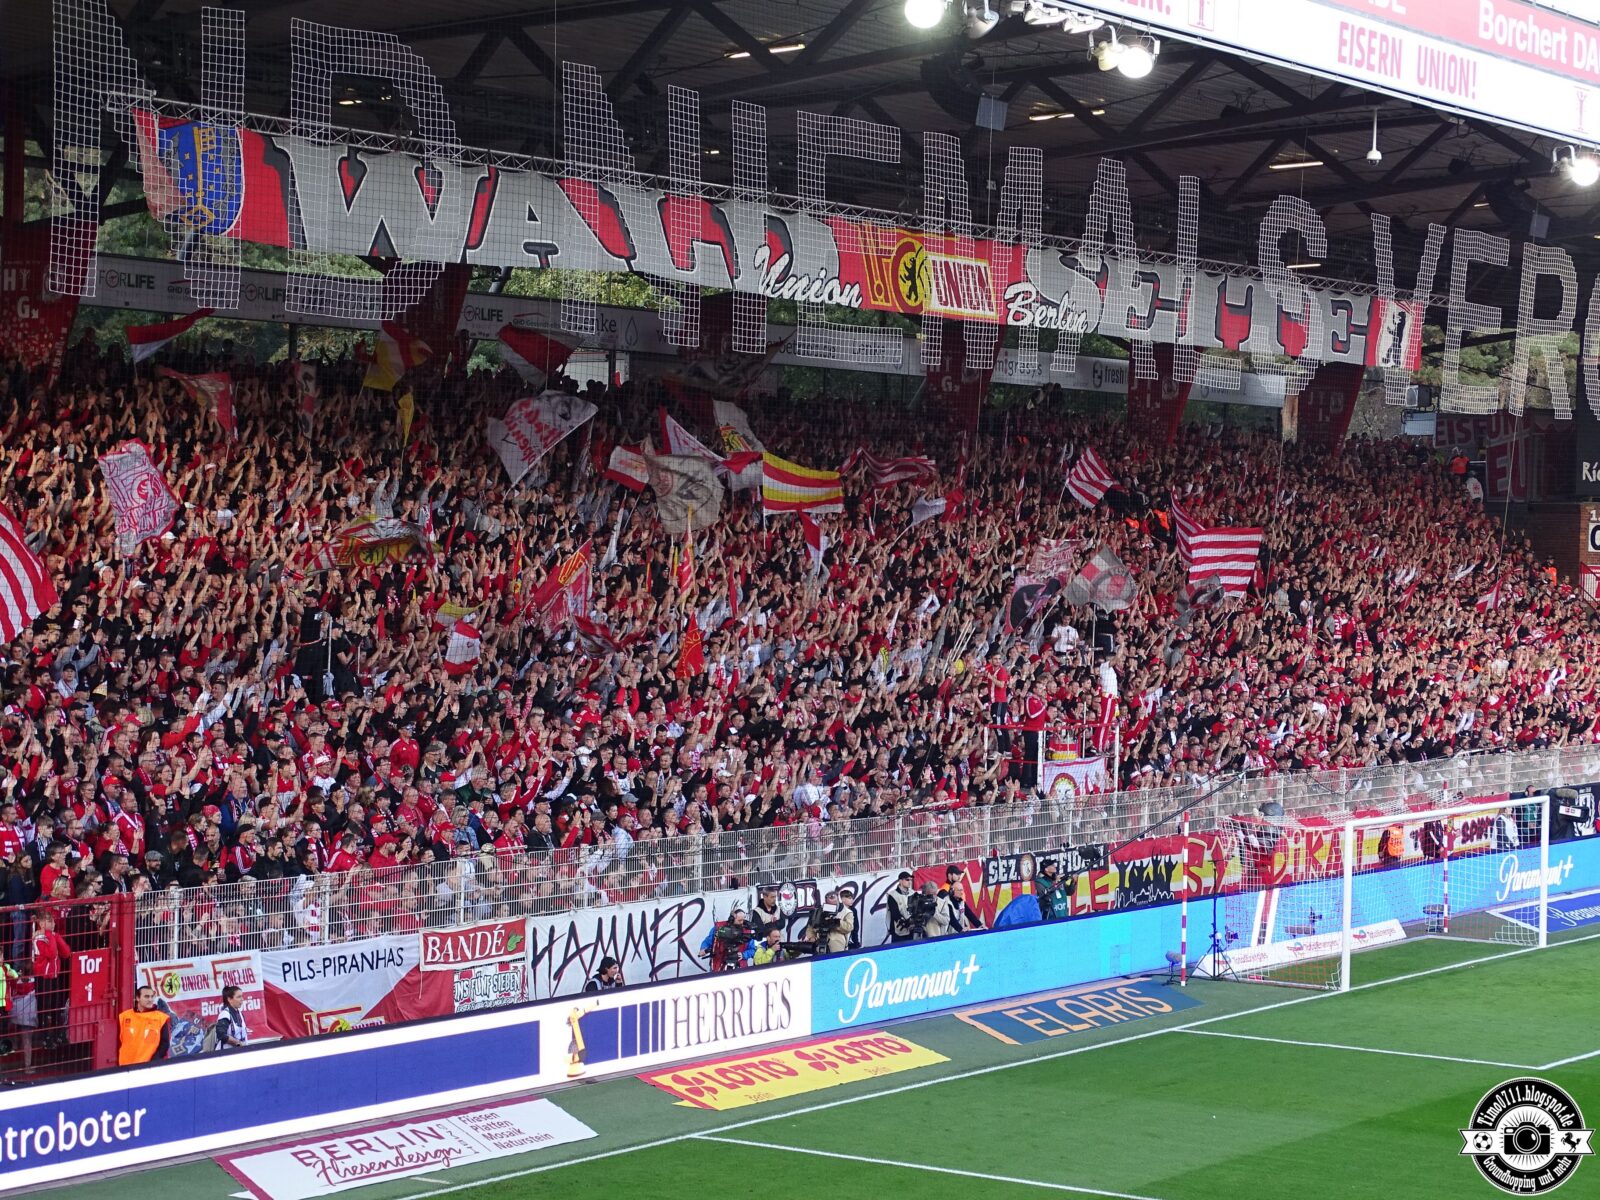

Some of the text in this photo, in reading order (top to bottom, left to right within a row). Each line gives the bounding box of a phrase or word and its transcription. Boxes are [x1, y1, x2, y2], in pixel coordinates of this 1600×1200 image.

[1478, 0, 1568, 65] Borchert
[1336, 20, 1478, 100] EISERN UNION!
[98, 268, 156, 290] FORLIFE
[754, 244, 862, 309] Union
[460, 304, 504, 322] ORLIFE
[1004, 280, 1088, 334] Berlin
[425, 924, 506, 963] BANDÉ
[531, 897, 708, 1000] HAMMER
[78, 954, 103, 975] Tor
[181, 972, 211, 993] UNION
[281, 946, 405, 983] PILS-PIRANHAS
[84, 982, 93, 1002] 1
[838, 951, 981, 1025] Paramount+
[670, 976, 793, 1050] HERRLES
[1001, 986, 1174, 1038] ELARIS
[826, 1036, 913, 1065] LOTTO
[700, 1058, 799, 1090] LOTTO
[0, 1107, 147, 1163] troboter
[470, 1118, 515, 1135] Platten
[480, 1127, 526, 1143] Mosaik
[493, 1132, 555, 1151] Naturstein
[290, 1125, 446, 1168] BERLIN
